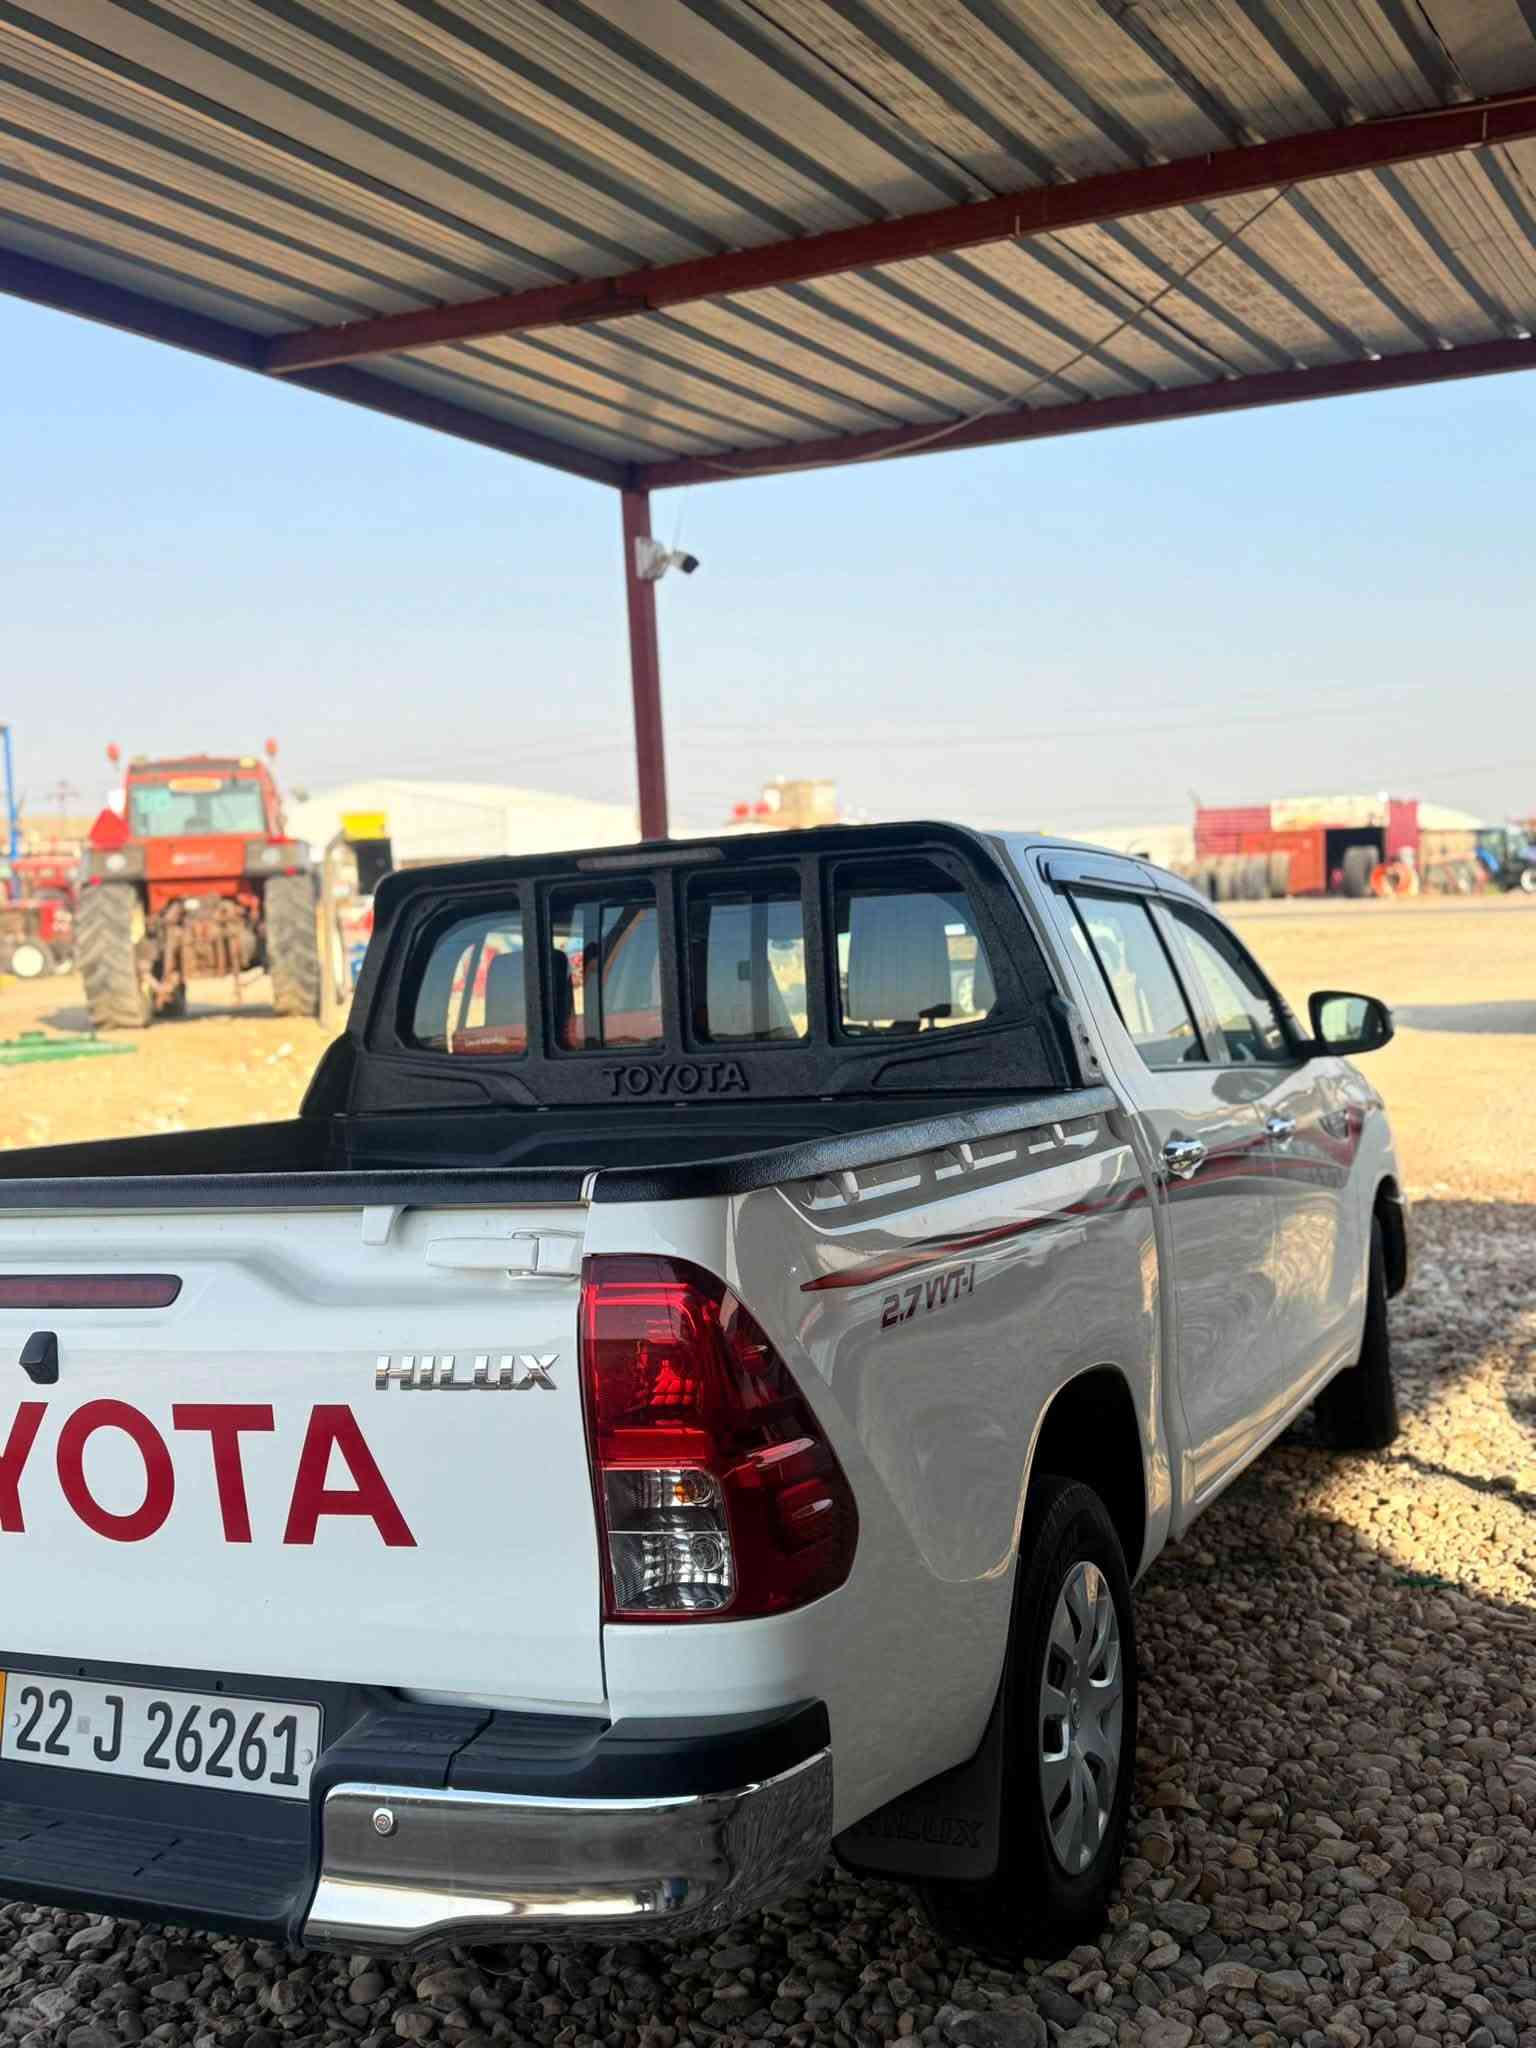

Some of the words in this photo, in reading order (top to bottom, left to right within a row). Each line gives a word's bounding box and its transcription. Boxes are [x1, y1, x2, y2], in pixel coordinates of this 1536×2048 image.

[601, 1061, 749, 1096] TOYOTA
[881, 1284, 922, 1329] 2.7
[375, 1355, 560, 1391] HILUX
[16, 1686, 73, 1756] 22
[93, 1695, 124, 1762] J
[143, 1700, 299, 1786] 26261
